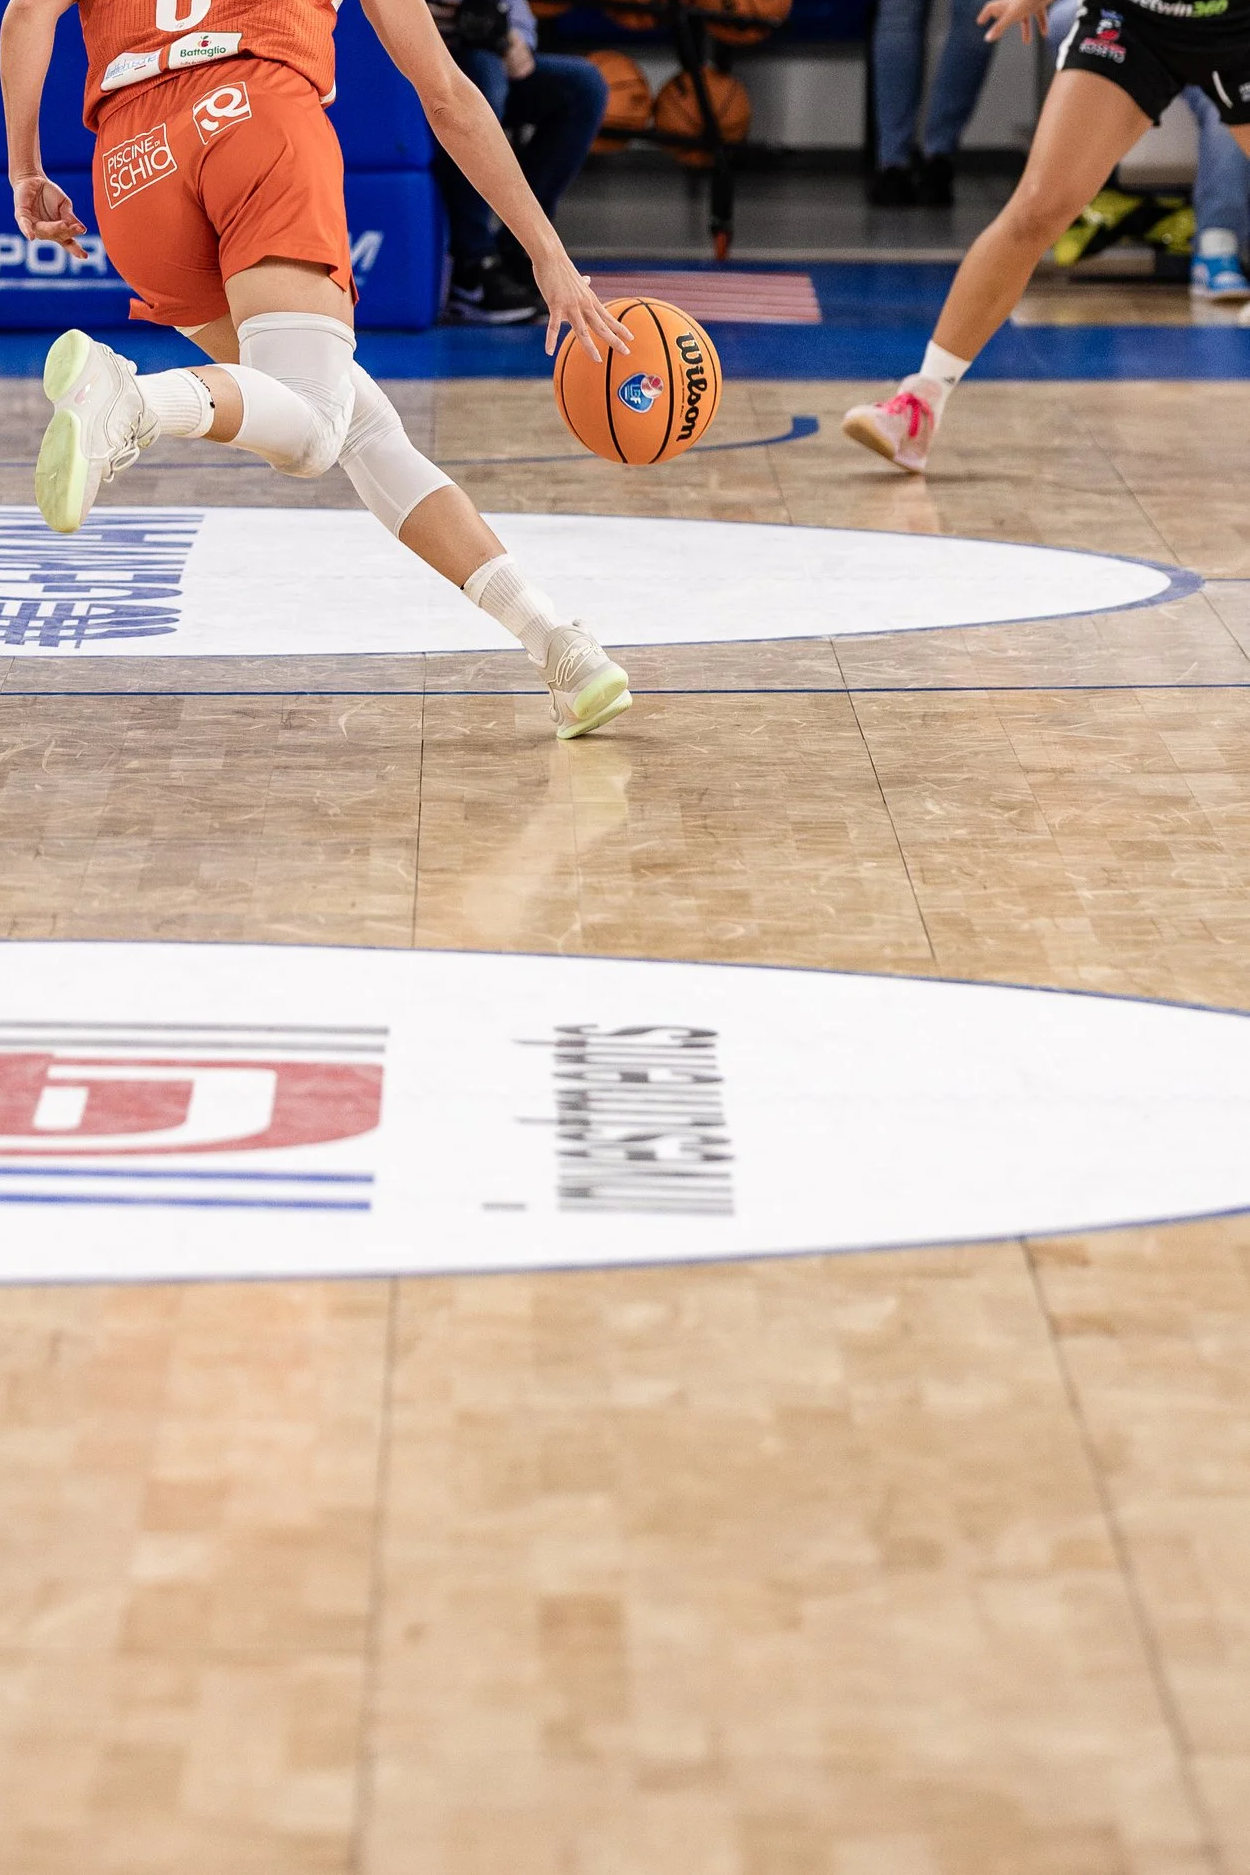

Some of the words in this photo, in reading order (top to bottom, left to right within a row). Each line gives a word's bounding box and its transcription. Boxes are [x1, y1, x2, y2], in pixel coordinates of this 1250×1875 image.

[179, 46, 227, 58] Battaglio
[107, 135, 154, 173] PISCINE
[109, 146, 171, 198] SCHIO
[676, 331, 708, 442] Wilson
